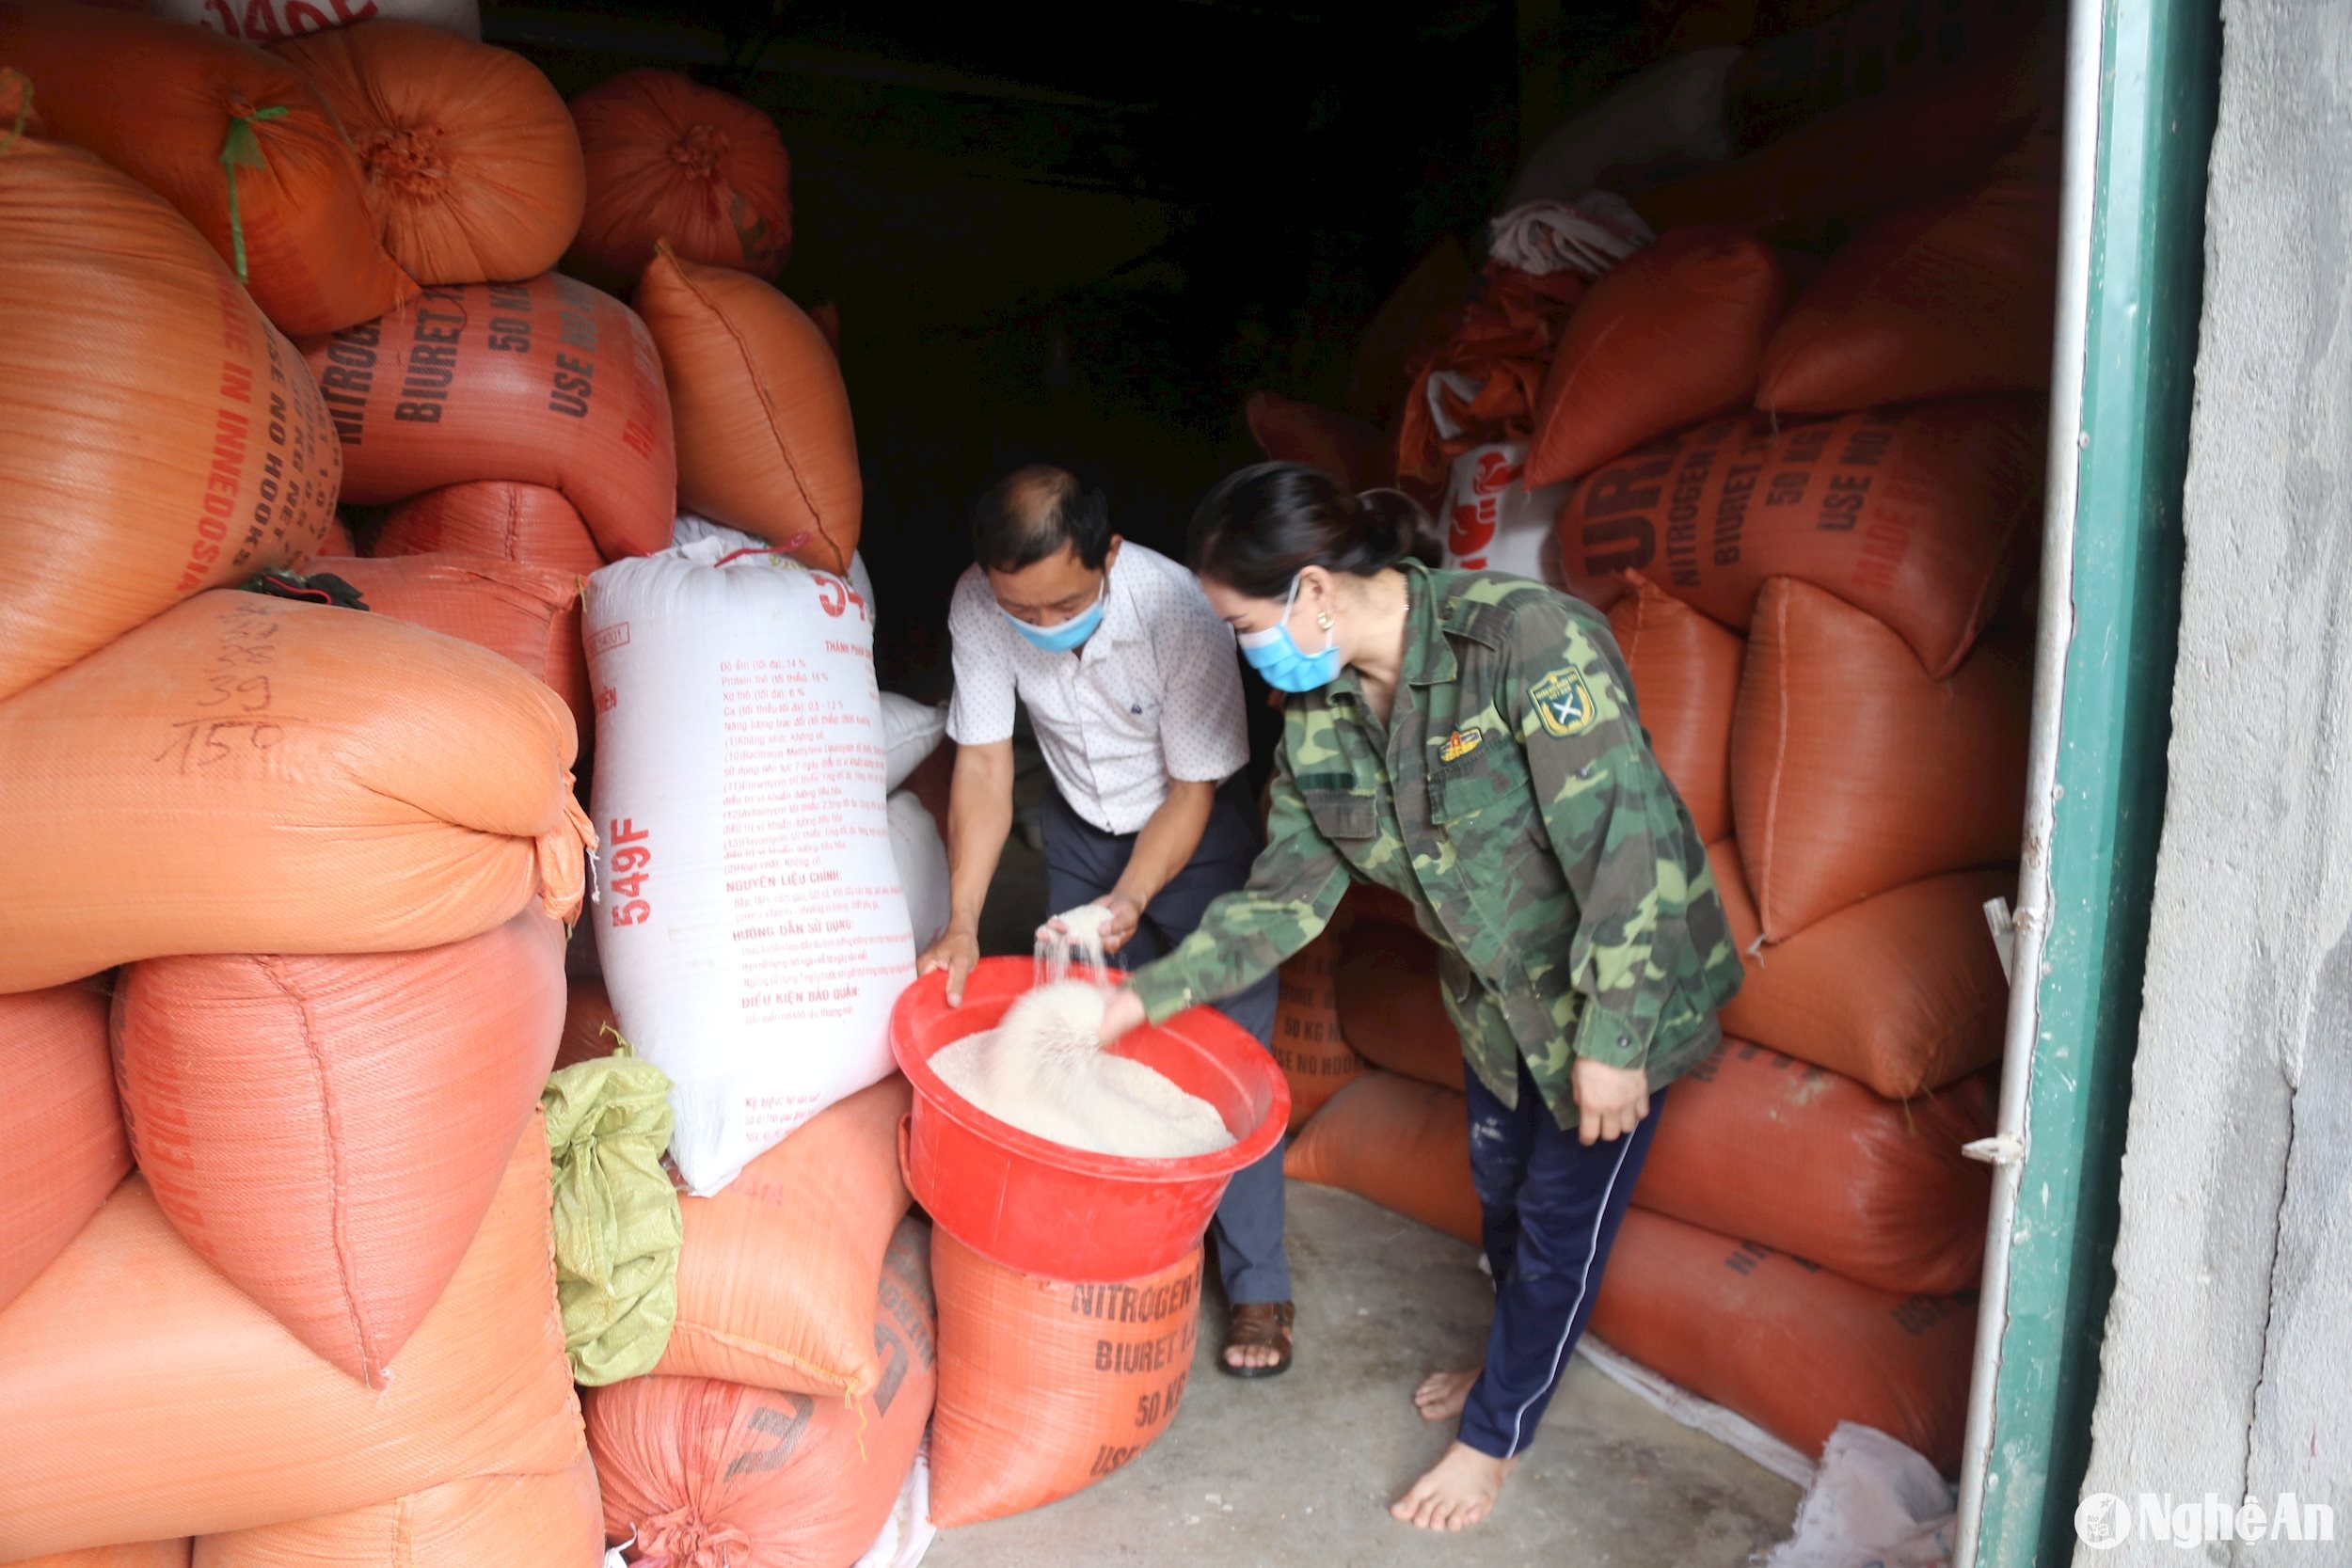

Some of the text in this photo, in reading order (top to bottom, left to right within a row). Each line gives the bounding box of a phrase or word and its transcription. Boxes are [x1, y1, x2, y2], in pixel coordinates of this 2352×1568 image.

[488, 315, 533, 354] 50
[559, 309, 599, 354] NO
[218, 359, 254, 404] IN
[394, 307, 463, 423] BIURET
[548, 351, 596, 420] USE
[267, 391, 287, 448] NO
[232, 451, 284, 568] HOOKS
[1765, 473, 1811, 507] 50
[1817, 475, 1872, 531] USE
[1666, 449, 1718, 588] NITROGEN
[1712, 463, 1763, 566] BIURET
[610, 816, 652, 928] 549F
[725, 874, 777, 894] NGUYÊN
[780, 871, 807, 888] LIỆU
[774, 988, 804, 1006] KIỆN
[1296, 1053, 1318, 1075] NO
[1072, 1274, 1193, 1323] NITROGEN
[1094, 1331, 1177, 1375] BIURET
[1135, 1390, 1161, 1429] 50
